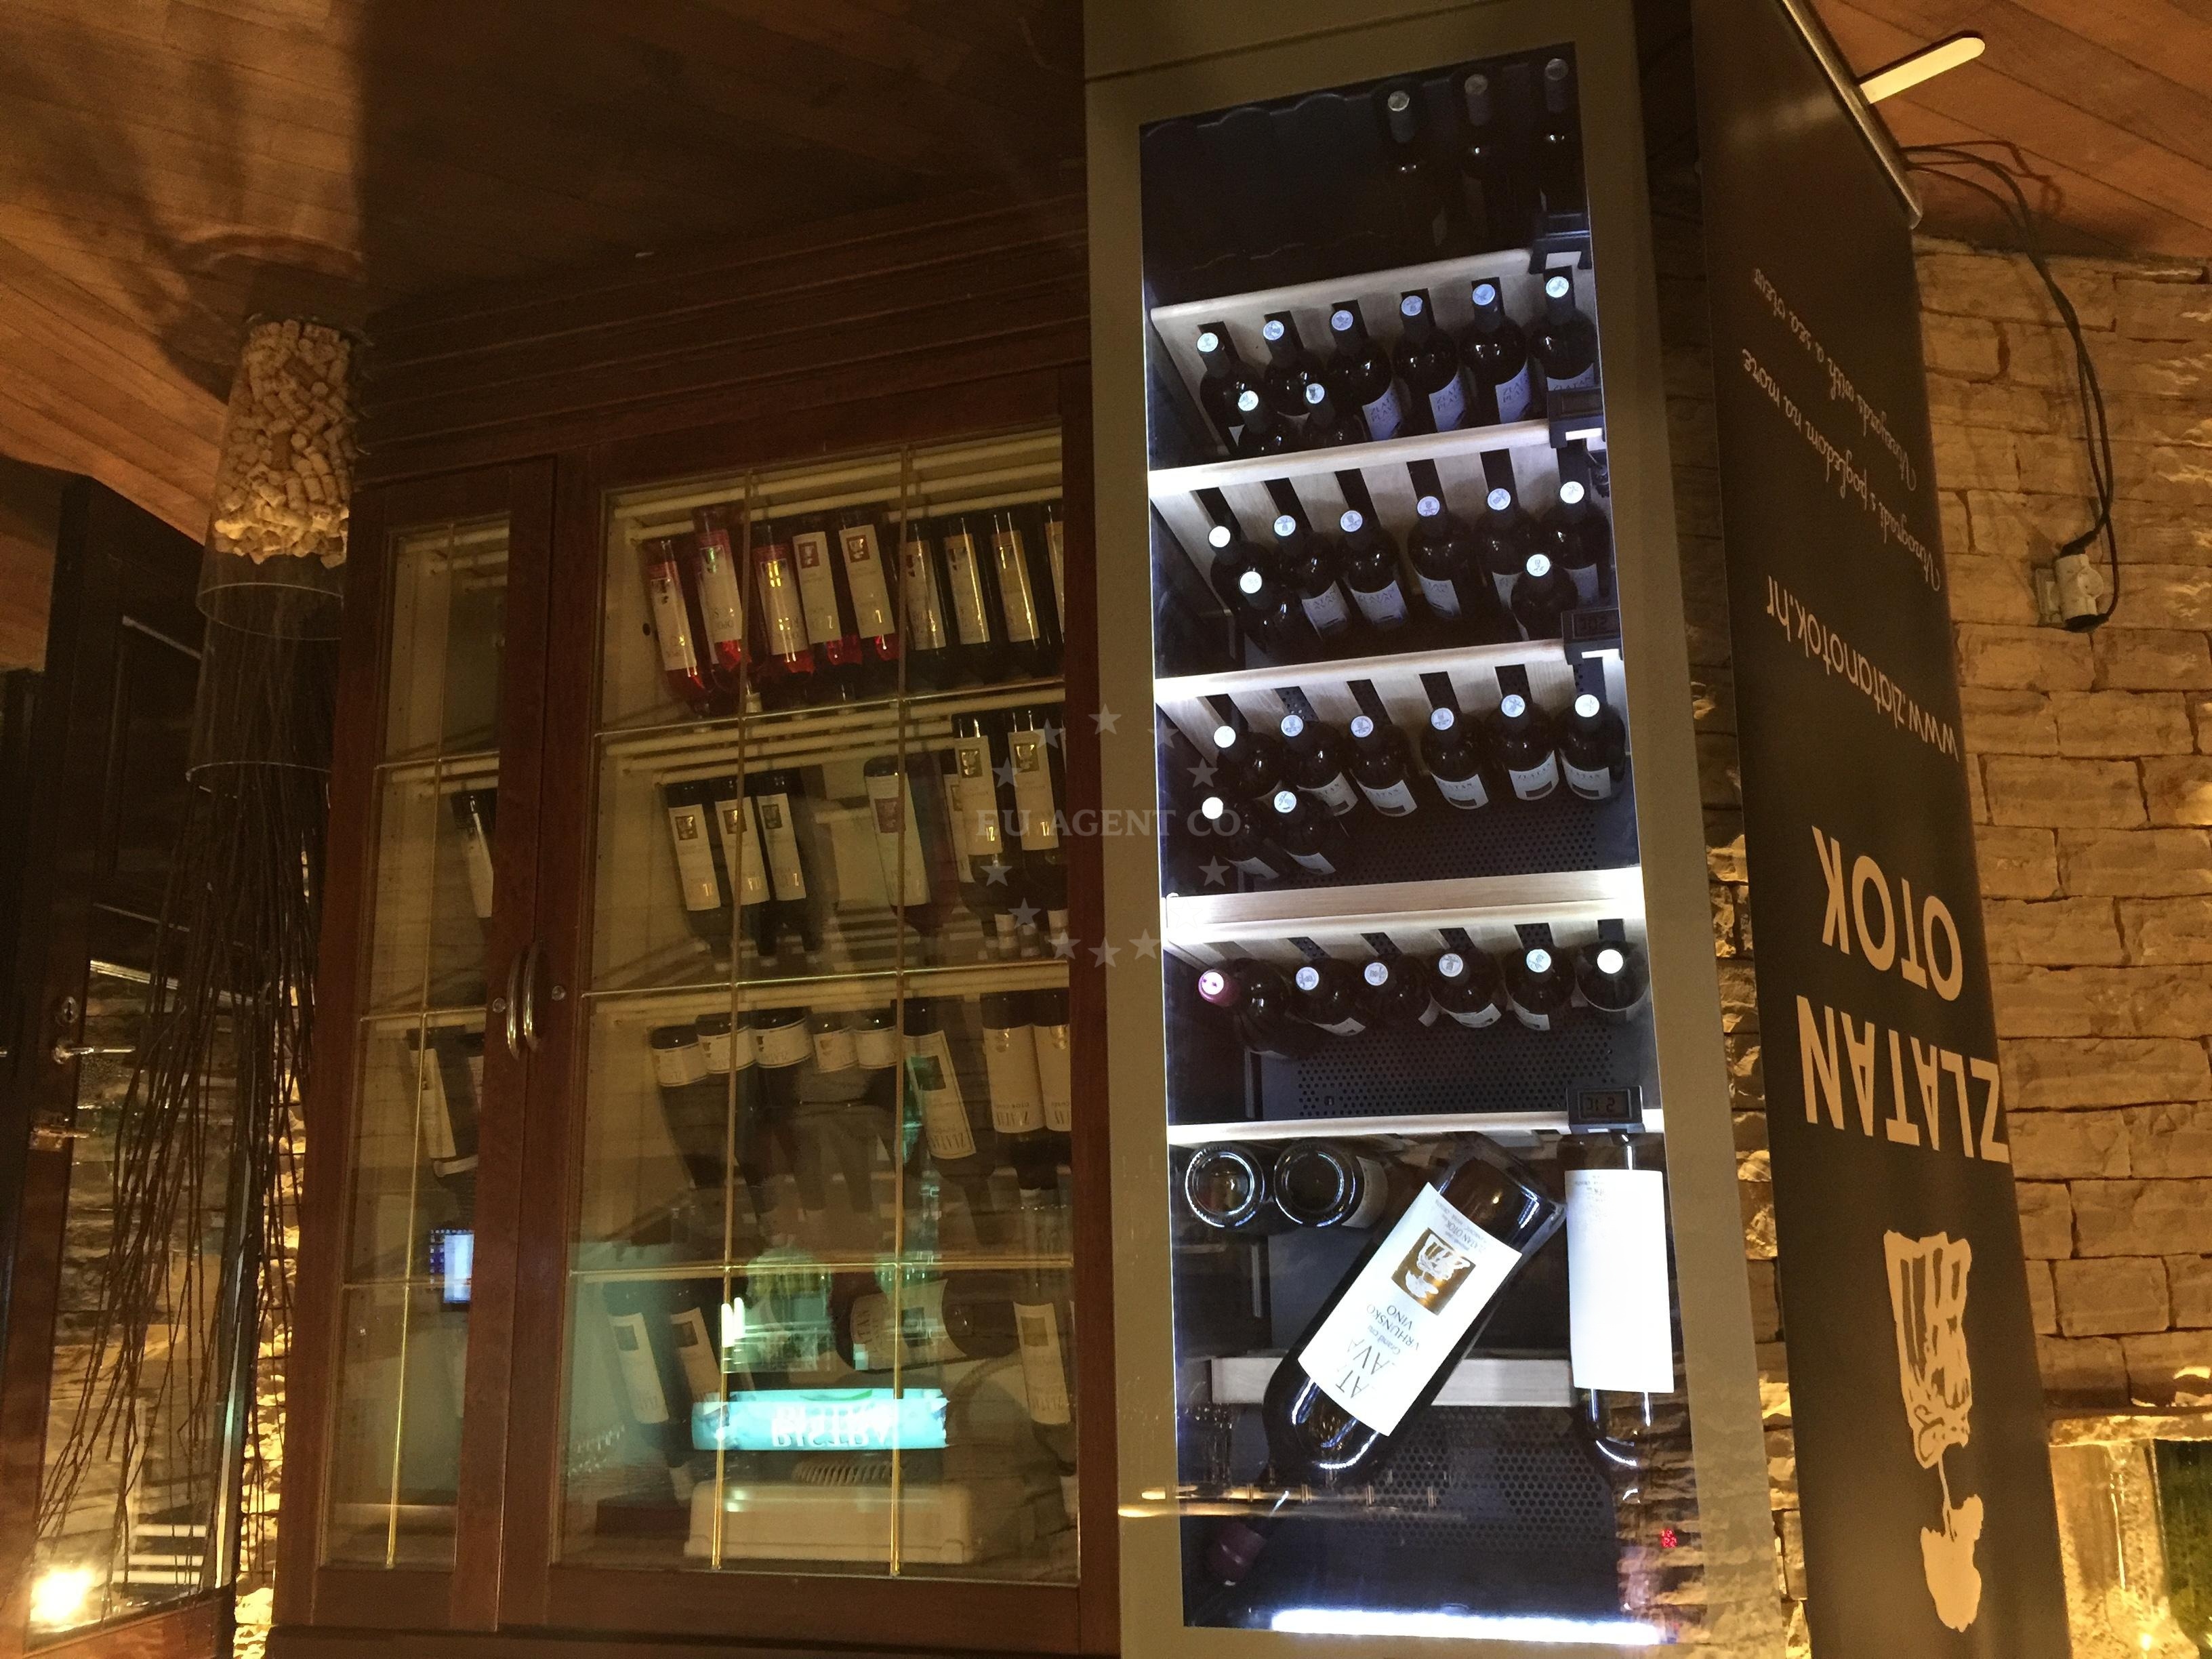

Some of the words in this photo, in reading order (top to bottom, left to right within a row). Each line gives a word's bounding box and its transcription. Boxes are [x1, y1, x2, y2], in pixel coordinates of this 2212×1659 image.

[1755, 268, 1785, 320] view
[1789, 311, 1811, 350] sea
[1816, 342, 1824, 363] a
[1742, 348, 1779, 407] more
[1828, 357, 1853, 400] with
[1784, 395, 1801, 432] na
[1805, 420, 1867, 510] pogledom
[1857, 394, 1917, 491] Vineyards
[1870, 492, 1876, 510] s
[1879, 501, 1940, 592] Vinogradi
[1767, 575, 1959, 762] www.zlatanotok.hr
[1811, 825, 1963, 1001] OTOK
[1797, 994, 2009, 1164] ZLATAN
[1366, 1303, 1419, 1351] VRHUNSKO
[1386, 1305, 1413, 1330] VINO
[1376, 1333, 1401, 1355] Grand
